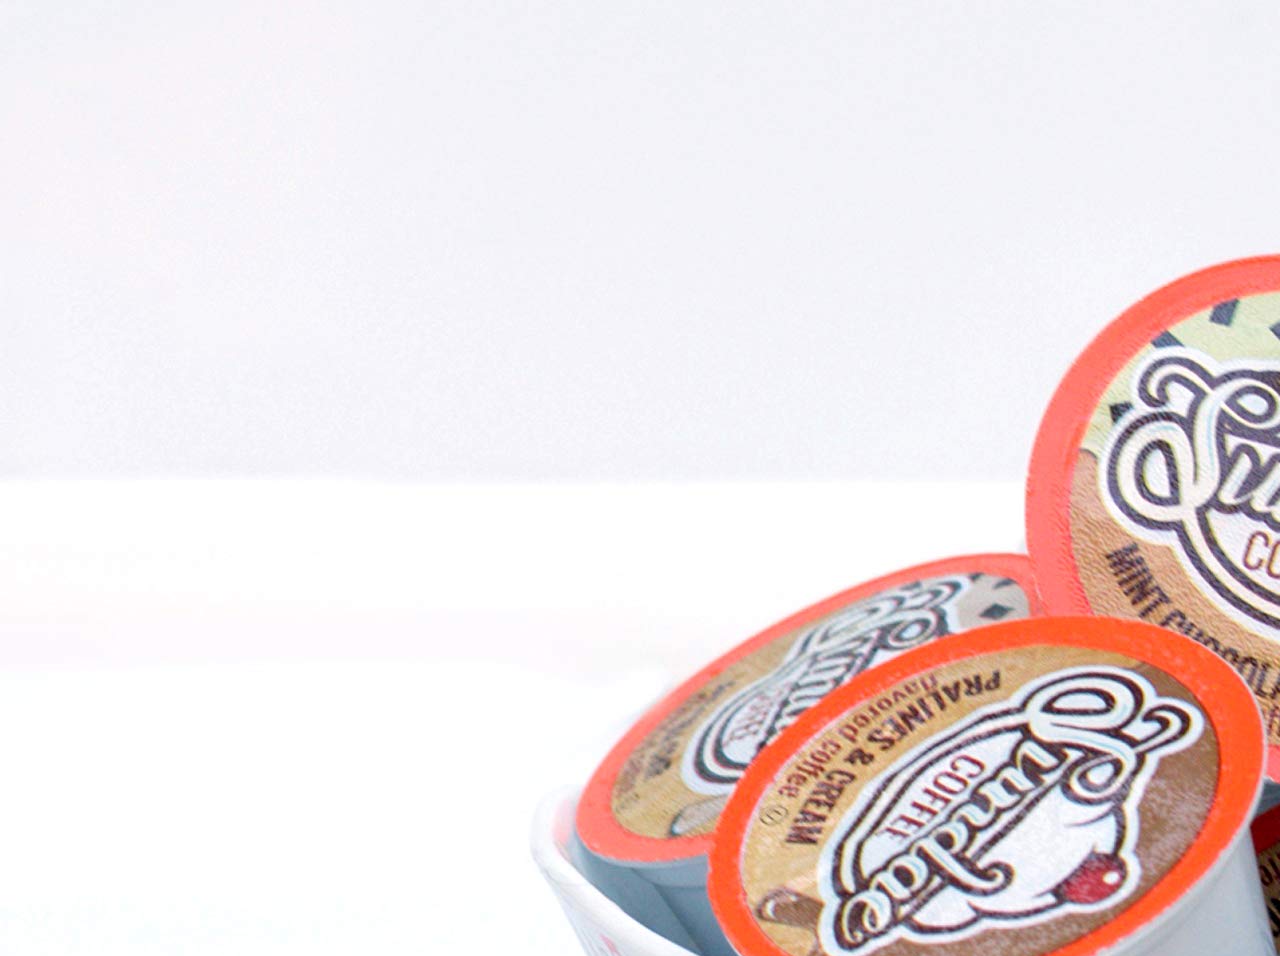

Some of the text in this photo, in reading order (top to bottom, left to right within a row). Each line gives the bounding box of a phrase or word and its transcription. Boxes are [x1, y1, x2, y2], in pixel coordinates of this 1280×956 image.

[1105, 542, 1172, 619] MINT
[777, 738, 842, 798] coffee
[785, 669, 1001, 846] PRALINES & CREAM
[876, 754, 986, 839] COFFEE
[834, 672, 1192, 950] Sundae
